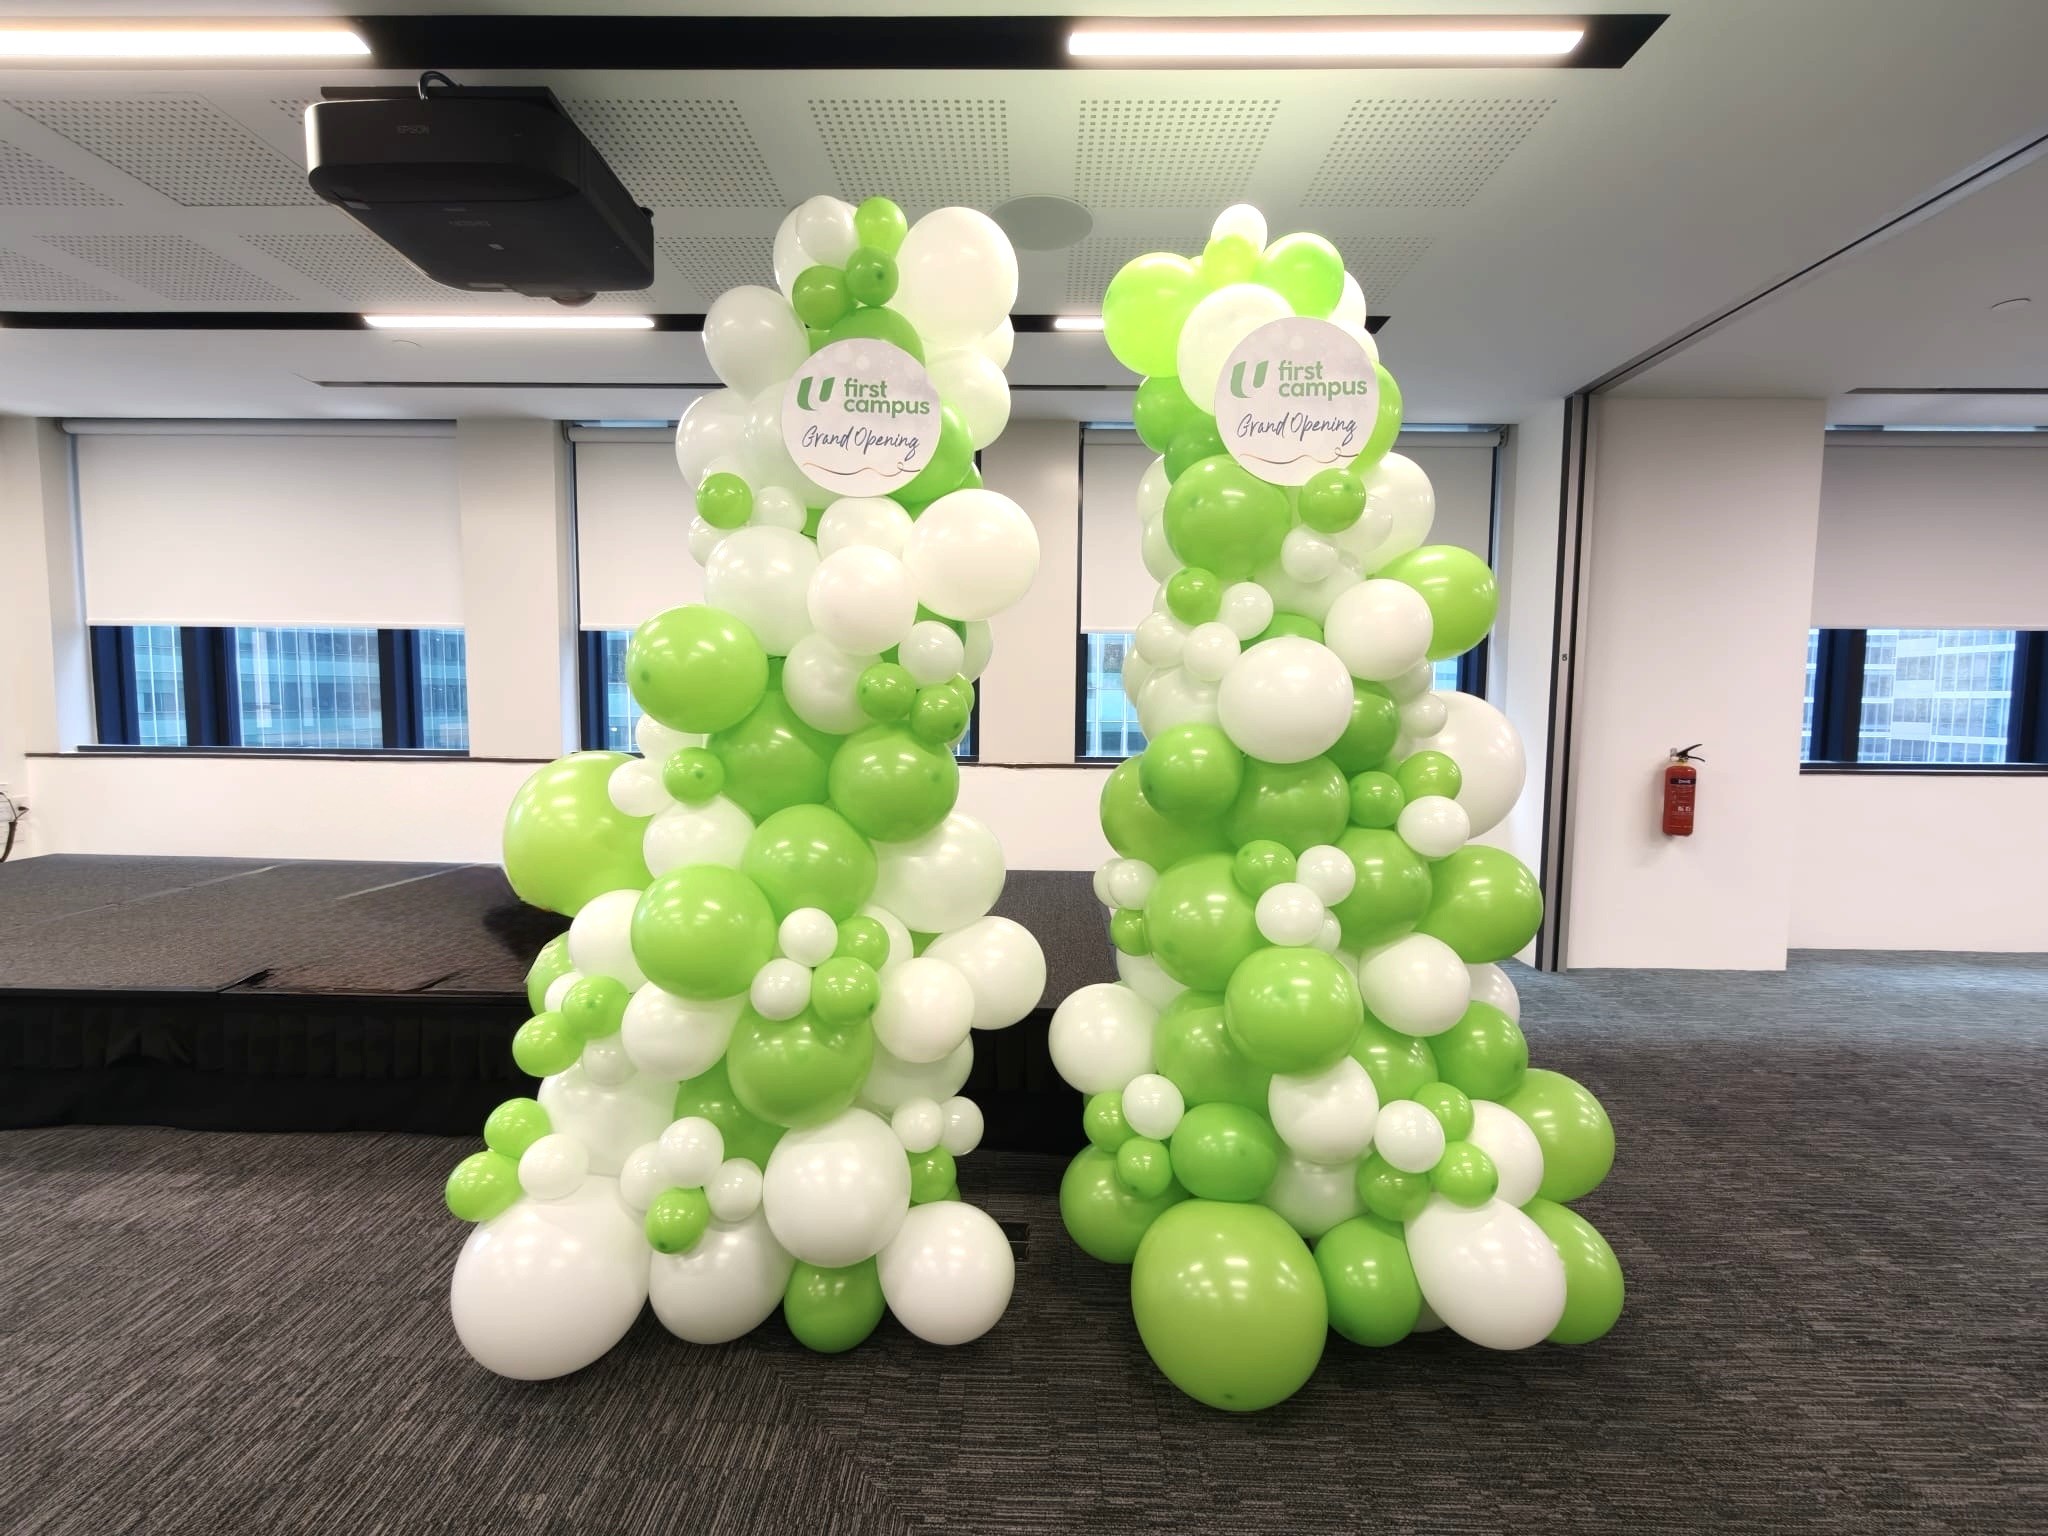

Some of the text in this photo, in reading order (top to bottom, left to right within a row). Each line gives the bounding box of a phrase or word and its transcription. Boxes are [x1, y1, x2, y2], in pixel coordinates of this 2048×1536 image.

[1278, 360, 1323, 381] first
[844, 378, 888, 398] first
[1278, 379, 1368, 401] campus
[843, 399, 930, 418] campus
[1237, 412, 1357, 447] Grand Opening
[802, 425, 920, 462] Grand Opening
